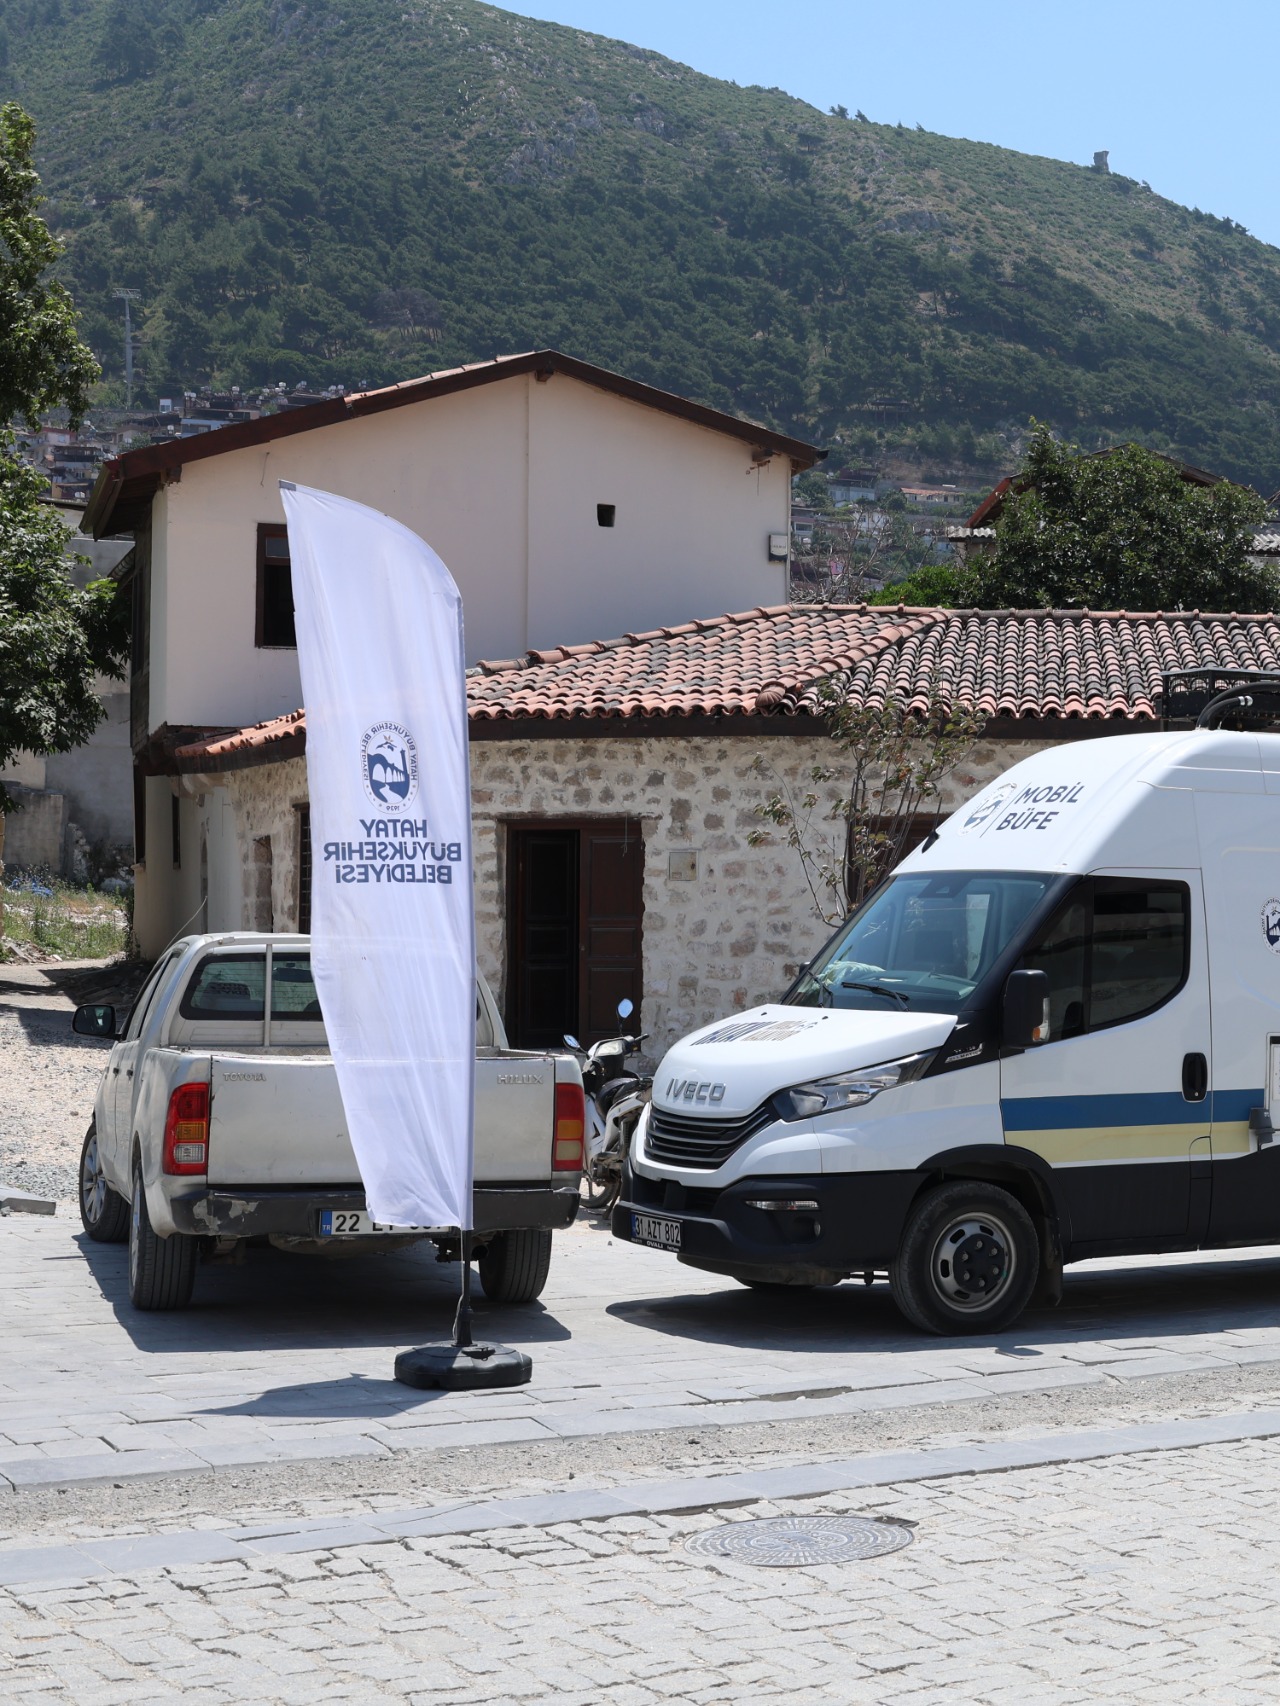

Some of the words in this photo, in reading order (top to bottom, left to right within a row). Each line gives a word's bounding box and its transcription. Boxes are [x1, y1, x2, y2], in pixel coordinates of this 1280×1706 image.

[1014, 781, 1085, 804] MOBİL
[995, 807, 1060, 830] BÜFE
[223, 1072, 267, 1081] TOYOTA
[497, 1074, 543, 1084] HILUX
[665, 1078, 726, 1101] IVECO
[335, 1213, 360, 1232] 22
[635, 1216, 643, 1236] 31
[647, 1219, 662, 1239] AZT
[665, 1223, 680, 1244] 802
